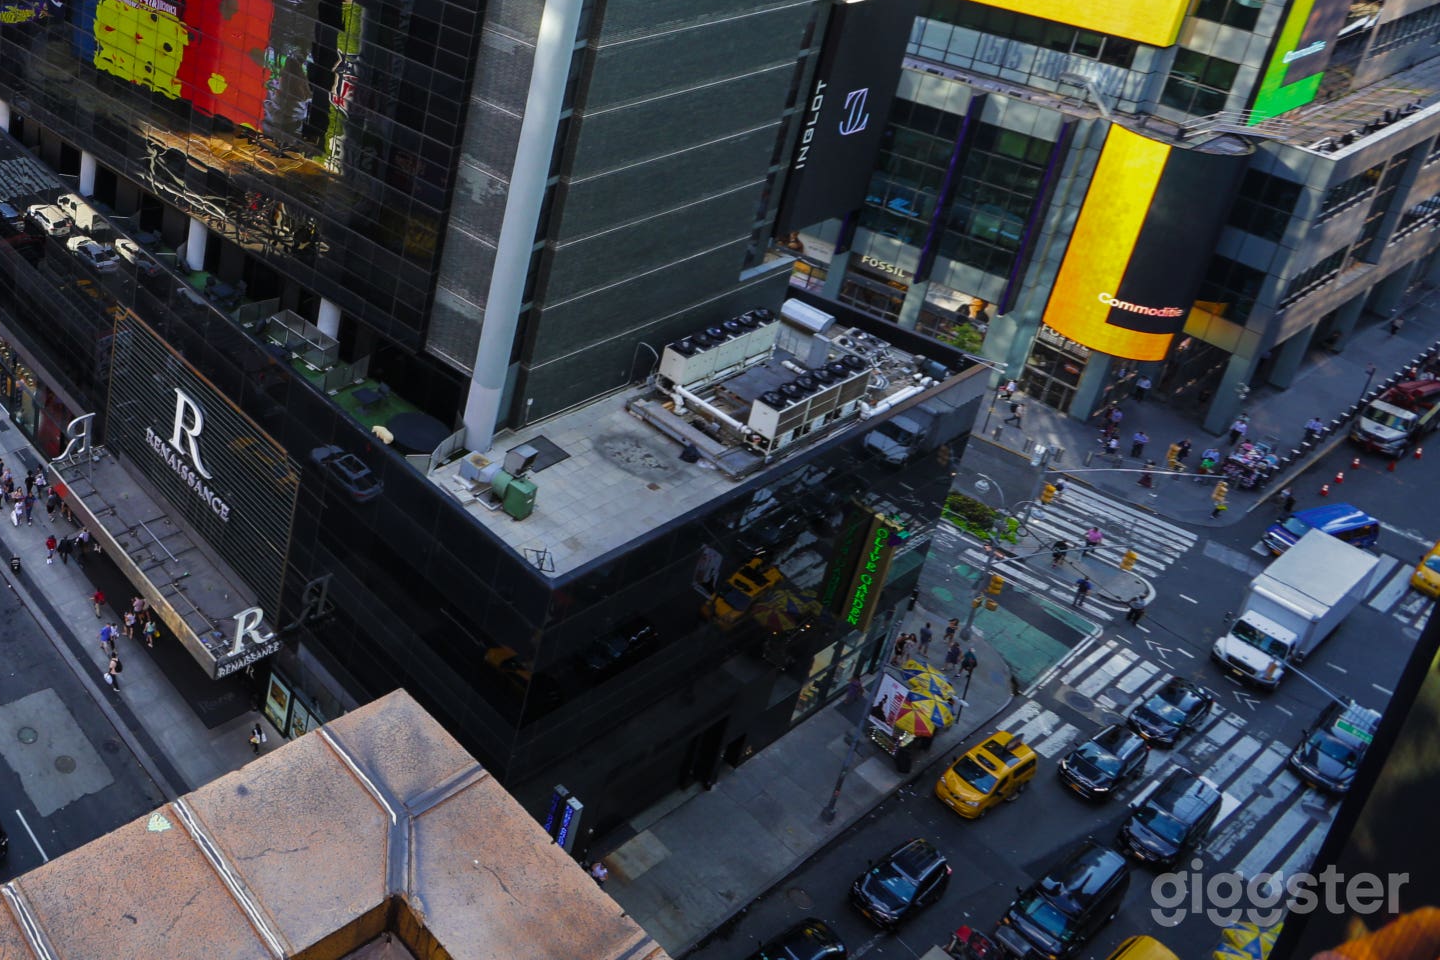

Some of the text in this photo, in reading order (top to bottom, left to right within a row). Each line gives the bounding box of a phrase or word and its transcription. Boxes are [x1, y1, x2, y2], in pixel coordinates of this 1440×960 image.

[980, 33, 1024, 71] 1515
[795, 79, 828, 170] INGLOT
[861, 255, 906, 279] FOSSIL
[169, 387, 213, 479] R
[146, 426, 231, 522] RENAISSANCE
[847, 528, 889, 625] OLIVE GARDEN
[216, 641, 281, 678] RENAISSANCE
[227, 606, 275, 657] R
